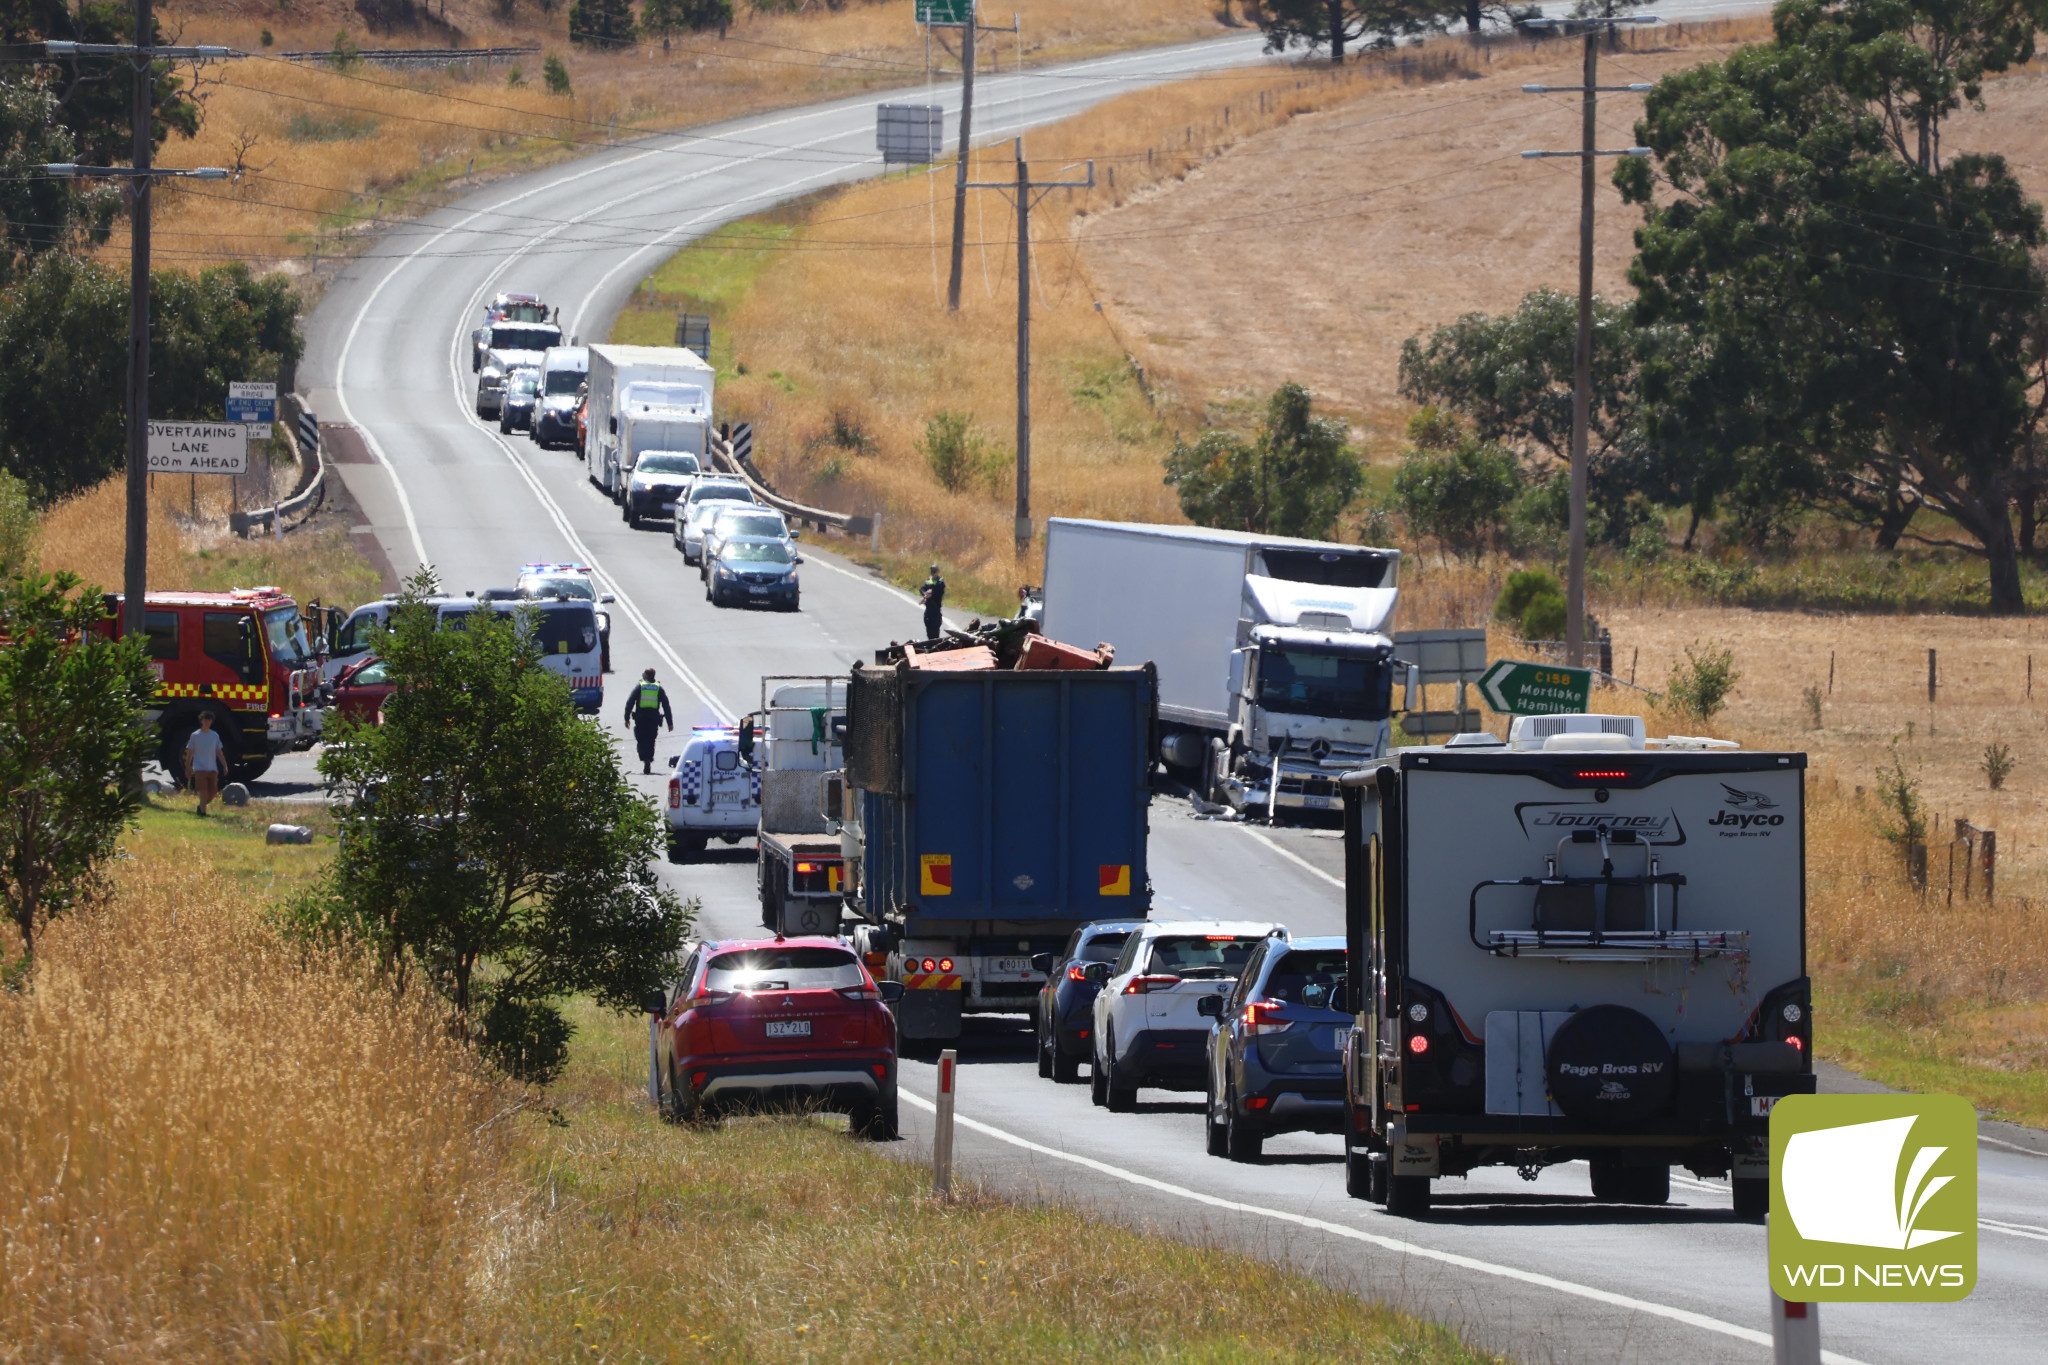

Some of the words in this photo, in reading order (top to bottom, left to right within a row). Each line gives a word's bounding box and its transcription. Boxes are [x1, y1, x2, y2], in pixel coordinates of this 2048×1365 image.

[148, 425, 236, 438] OVERTAKING
[172, 442, 209, 453] LANE
[147, 456, 182, 466] 00m
[190, 457, 239, 468] AHEAD
[1535, 671, 1571, 686] C158
[1520, 684, 1582, 701] Mortlake
[246, 703, 267, 711] FIRE
[1517, 698, 1581, 714] Hamilton
[1533, 811, 1670, 829] Journey
[1708, 810, 1785, 829] Jayco
[1560, 1063, 1599, 1076] Page
[1602, 1063, 1638, 1074] Bros
[1641, 1062, 1664, 1073] RV
[1595, 1091, 1631, 1100] Jayco
